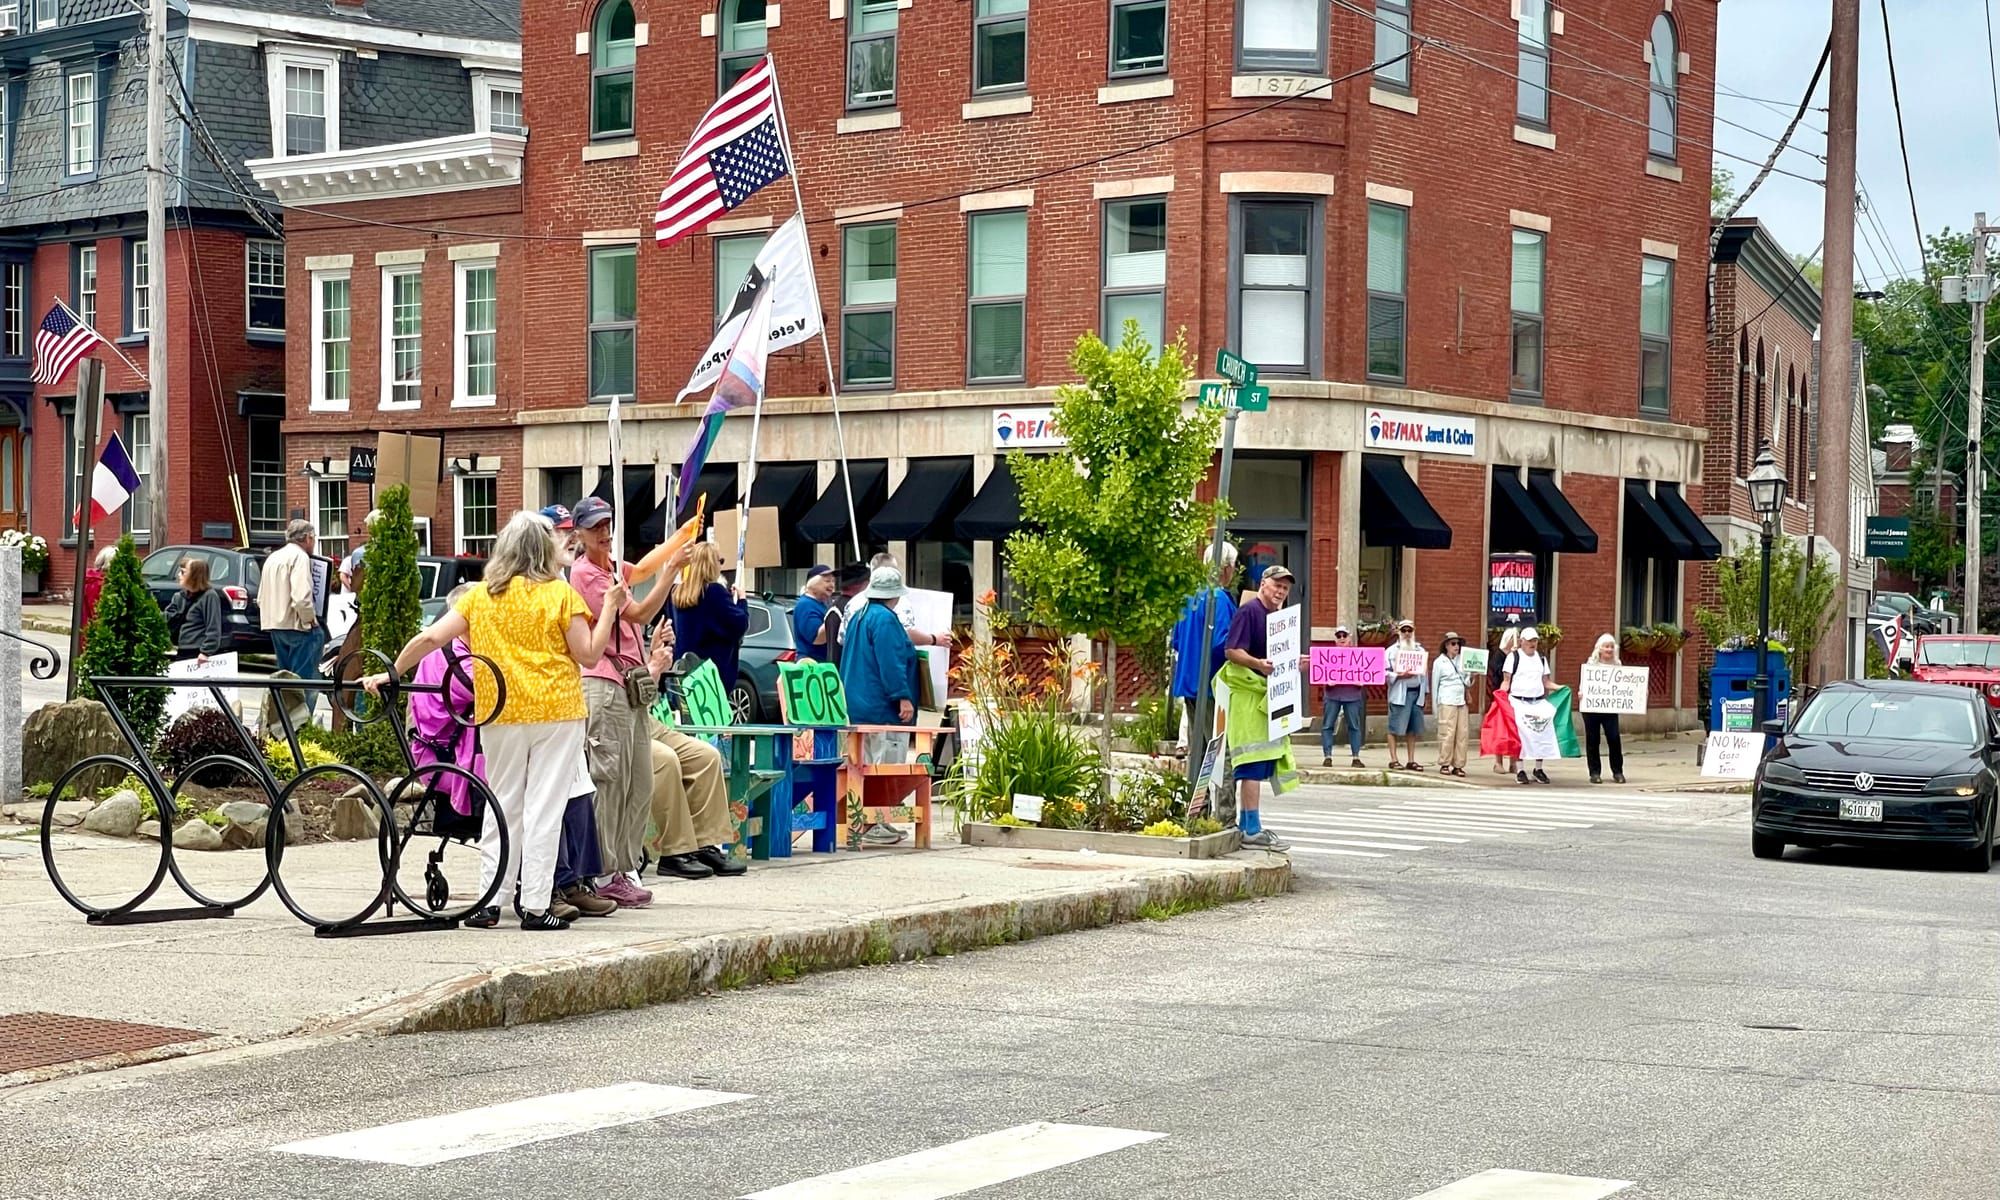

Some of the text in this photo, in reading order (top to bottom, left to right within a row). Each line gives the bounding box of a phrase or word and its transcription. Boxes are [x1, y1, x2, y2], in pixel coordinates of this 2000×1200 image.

[1257, 77, 1309, 93] 1874
[1222, 353, 1247, 386] CHURCH
[1205, 386, 1262, 409] MAIN ST
[1381, 421, 1423, 442] RE/MAX
[1446, 428, 1452, 444] &
[1453, 428, 1474, 446] Cohn
[1491, 561, 1535, 577] IMPEACH
[1491, 577, 1535, 592] REMOVE
[1491, 592, 1535, 608] CONVICT
[1319, 649, 1376, 670] Not My
[1312, 664, 1381, 683] Dictator
[691, 668, 726, 726] BY
[785, 669, 847, 724] FOR
[1585, 697, 1634, 710] DISAPPEAR
[1711, 735, 1751, 751] NO War
[1847, 804, 1881, 817] 6101 ZU
